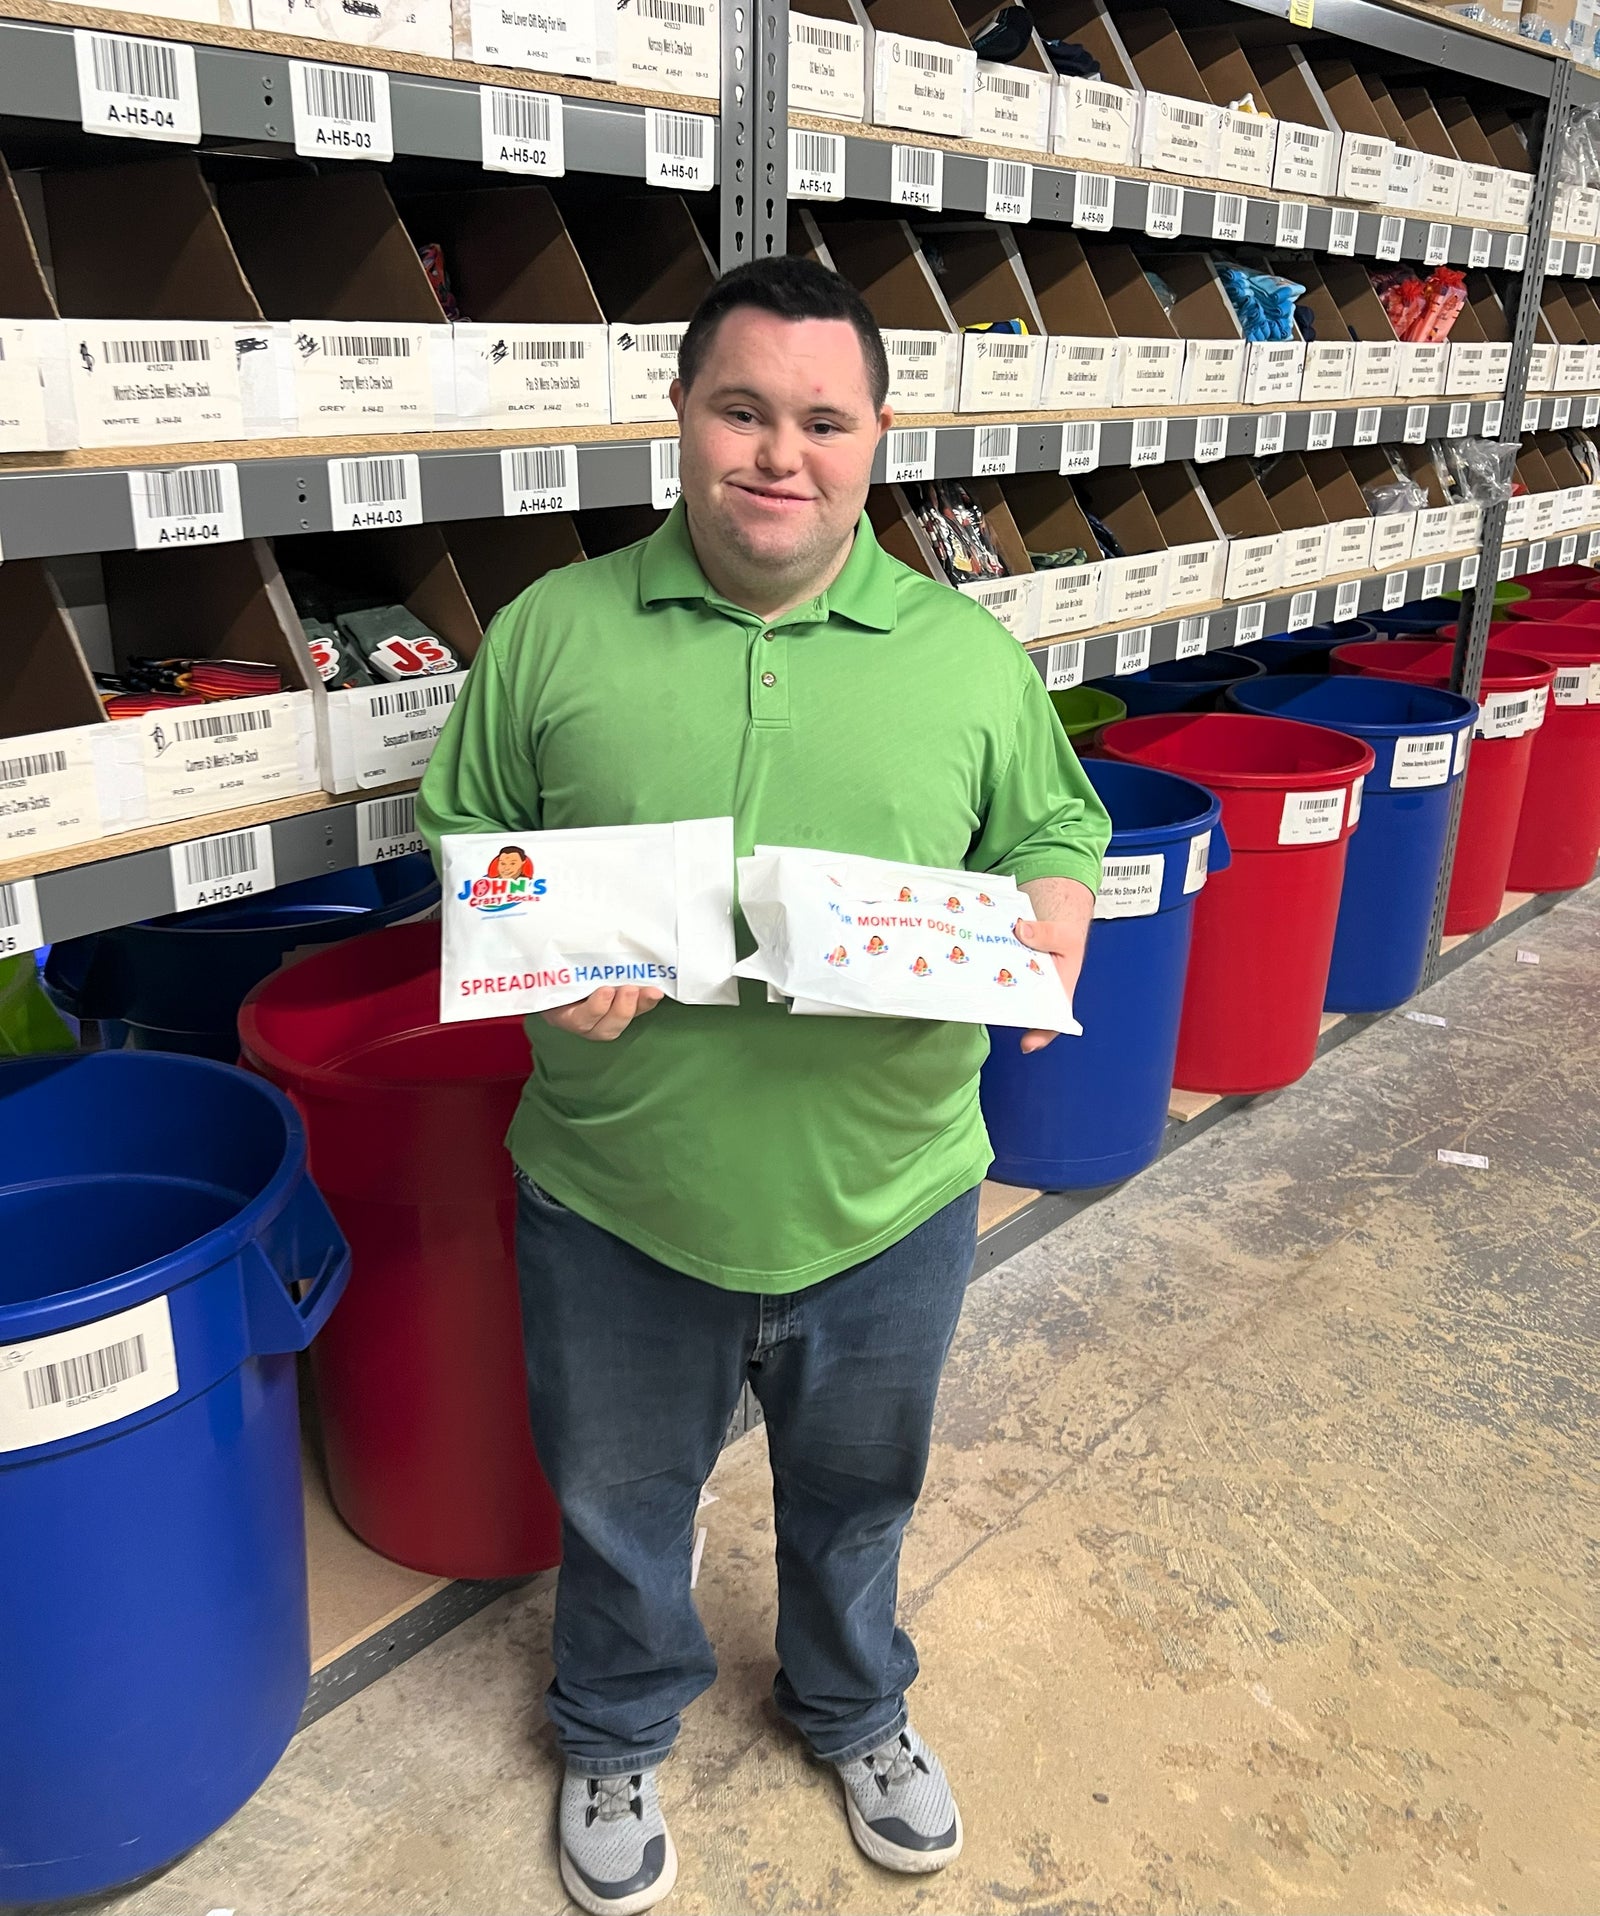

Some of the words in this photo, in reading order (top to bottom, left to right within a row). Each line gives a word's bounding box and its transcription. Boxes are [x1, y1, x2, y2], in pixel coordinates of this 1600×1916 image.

[501, 9, 513, 24] Beer
[514, 12, 528, 26] Lover
[528, 14, 537, 28] Gift
[538, 16, 548, 33] Bag
[548, 18, 557, 31] For
[557, 19, 567, 32] Him
[486, 45, 499, 54] MEN
[632, 63, 658, 72] BLACK
[791, 83, 813, 92] GREEN
[107, 104, 175, 129] A-H5-04
[316, 128, 373, 149] A-H5-03
[500, 146, 547, 165] A-H5-02
[660, 163, 699, 180] A-H5-01
[799, 180, 832, 194] A-F5-12
[901, 191, 930, 205] A-F5-11
[995, 202, 1021, 214] A-F5-10
[1081, 211, 1104, 224] A-F5-09
[1153, 219, 1173, 232] A-F5-08
[165, 383, 182, 398] Men's
[182, 382, 196, 397] Crew
[197, 382, 212, 397] Sock
[355, 375, 369, 390] Men's
[369, 375, 382, 390] Crew
[382, 375, 393, 390] Sock
[103, 417, 140, 425] WHITE
[1068, 457, 1090, 467] A-F4-09
[1138, 452, 1158, 461] A-F4-08
[896, 469, 922, 480] A-F4-11
[981, 463, 1006, 474] A-F4-10
[520, 497, 563, 512] A-H4-02
[352, 509, 403, 527] A-H4-03
[159, 525, 220, 544] A-H4-04
[386, 641, 444, 672] J's
[1053, 674, 1074, 685] A-F3-09
[383, 731, 409, 748] Sasquatch
[410, 728, 432, 742] Women's
[230, 752, 244, 765] Crew
[244, 749, 259, 763] Sock
[364, 769, 386, 778] WOMEN
[173, 787, 195, 795] RED
[376, 840, 423, 860] A-H3-03
[197, 880, 254, 905] A-H3-04
[458, 879, 547, 900] JOHN'S
[1114, 887, 1122, 896] No
[1122, 887, 1136, 896] Show
[1141, 884, 1153, 895] Pack
[469, 896, 502, 907] Crazy
[506, 894, 541, 902] Socks
[857, 916, 922, 928] MONTHLY
[927, 918, 956, 937] DOSE
[959, 928, 972, 940] OF
[575, 963, 677, 983] HAPPINESS
[460, 968, 571, 996] SPREADING
